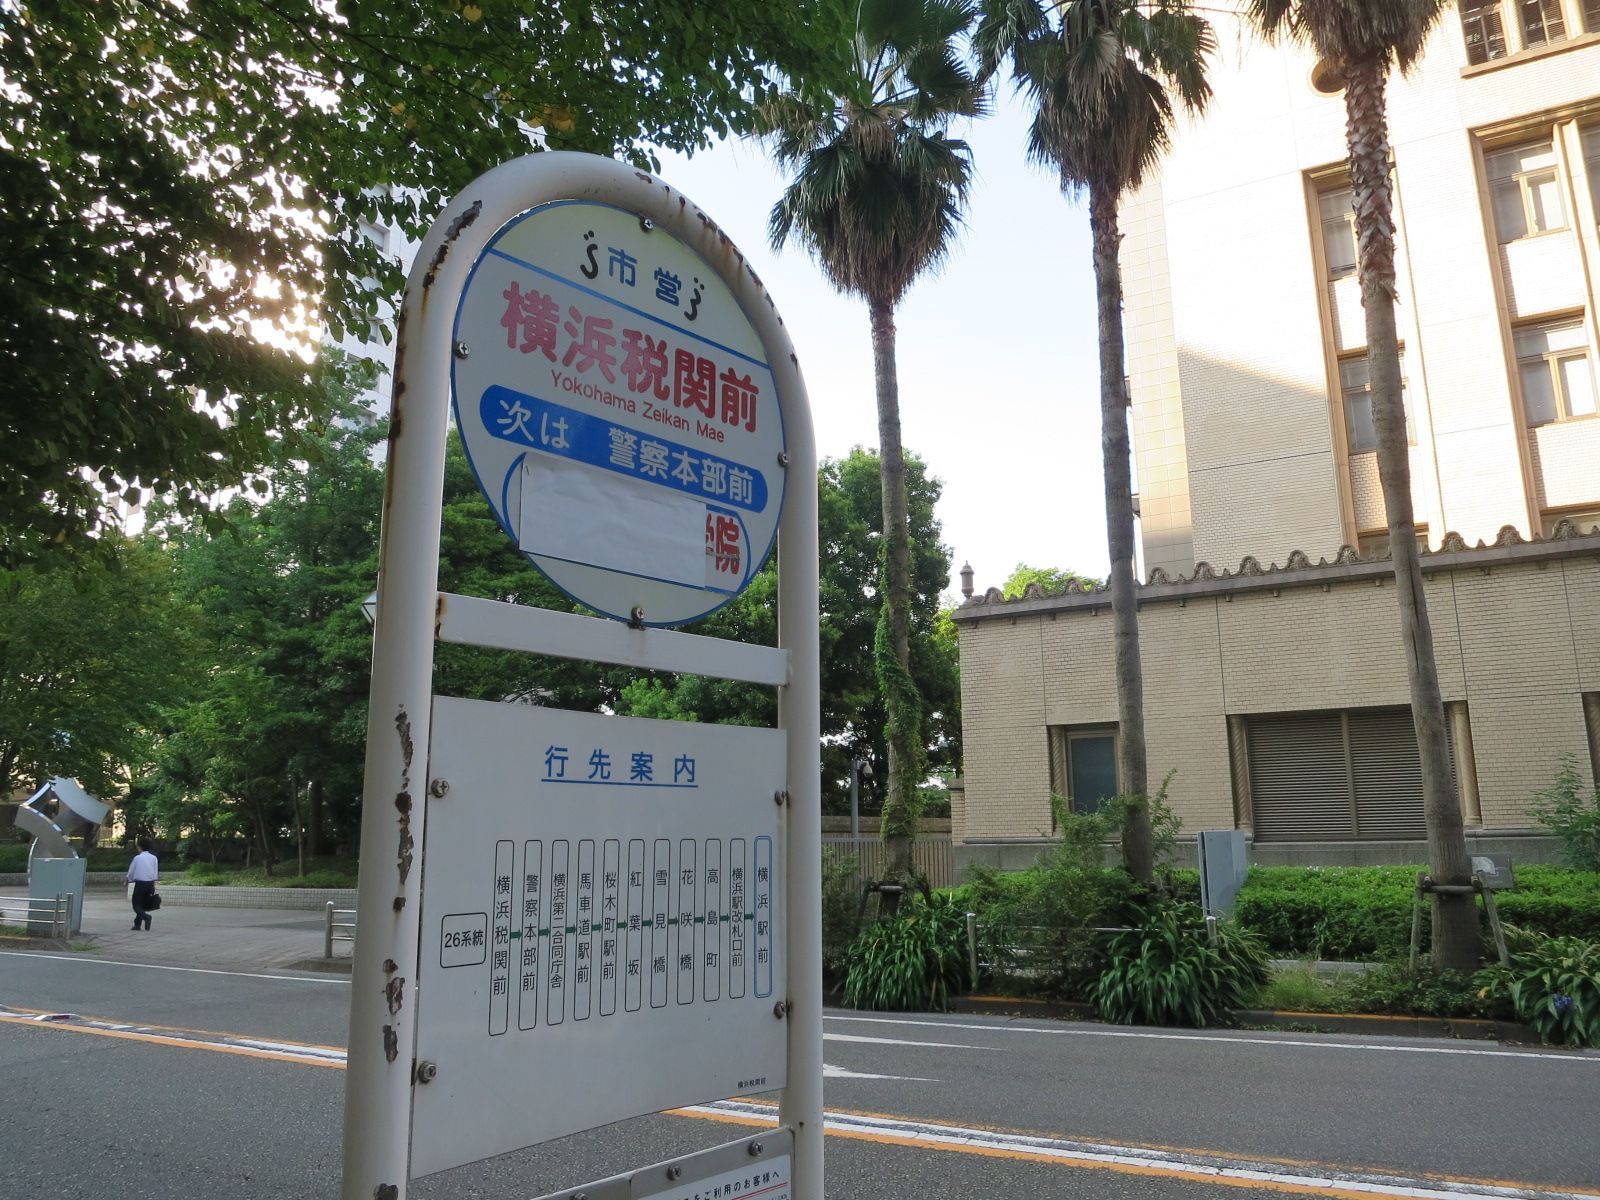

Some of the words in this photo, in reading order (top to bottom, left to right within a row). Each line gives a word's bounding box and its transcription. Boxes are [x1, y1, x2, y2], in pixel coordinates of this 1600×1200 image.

[607, 246, 682, 307] 市営
[500, 281, 759, 432] 横浜税関前
[551, 369, 636, 413] Yokohama
[642, 401, 690, 432] Zeikan
[696, 420, 725, 443] Mae
[497, 400, 570, 449] 次は
[608, 427, 753, 504] 警察本部前
[545, 745, 696, 783] 行先案内
[444, 930, 484, 948] 26系統
[493, 875, 511, 996] 横浜税関前
[522, 874, 539, 992] 警察本部前
[550, 873, 566, 989] 横浜第二合同庁舎
[577, 872, 591, 984] 馬車道駅前
[603, 871, 617, 980] 桜木町駅前
[628, 871, 642, 976] 紅葉坂
[653, 870, 668, 974] 雪見橋
[680, 869, 694, 971] 花咲橋
[706, 868, 719, 968] 高島町
[731, 867, 744, 967] 横浜駅改札口前
[757, 866, 769, 964] 横浜駅前
